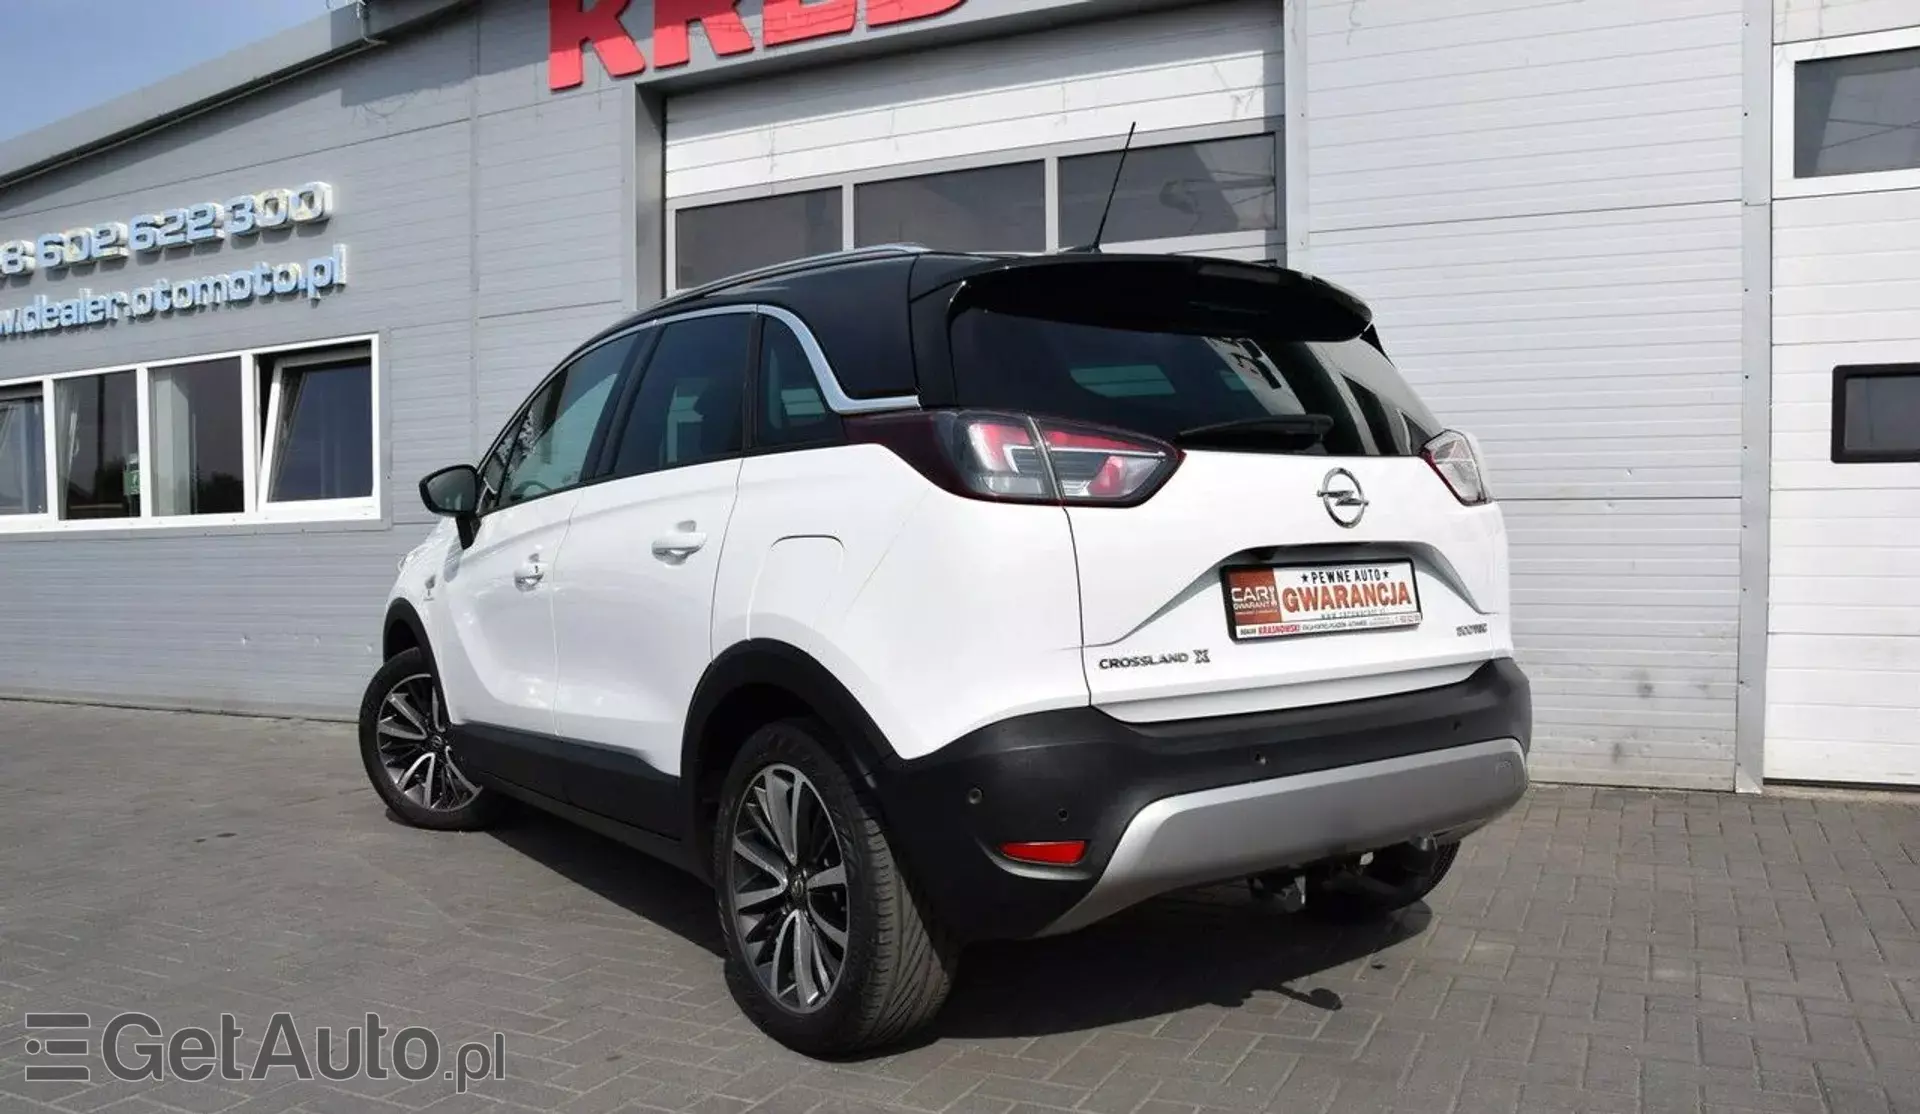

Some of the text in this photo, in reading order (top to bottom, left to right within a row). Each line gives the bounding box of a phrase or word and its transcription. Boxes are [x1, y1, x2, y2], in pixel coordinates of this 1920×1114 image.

[37, 222, 129, 268] 602
[128, 203, 225, 251] 622
[223, 181, 333, 236] 300
[1311, 568, 1381, 584] PEWNE AUTO
[1282, 581, 1412, 612] GWARANCJA
[1099, 649, 1210, 669] CROSSLAND X
